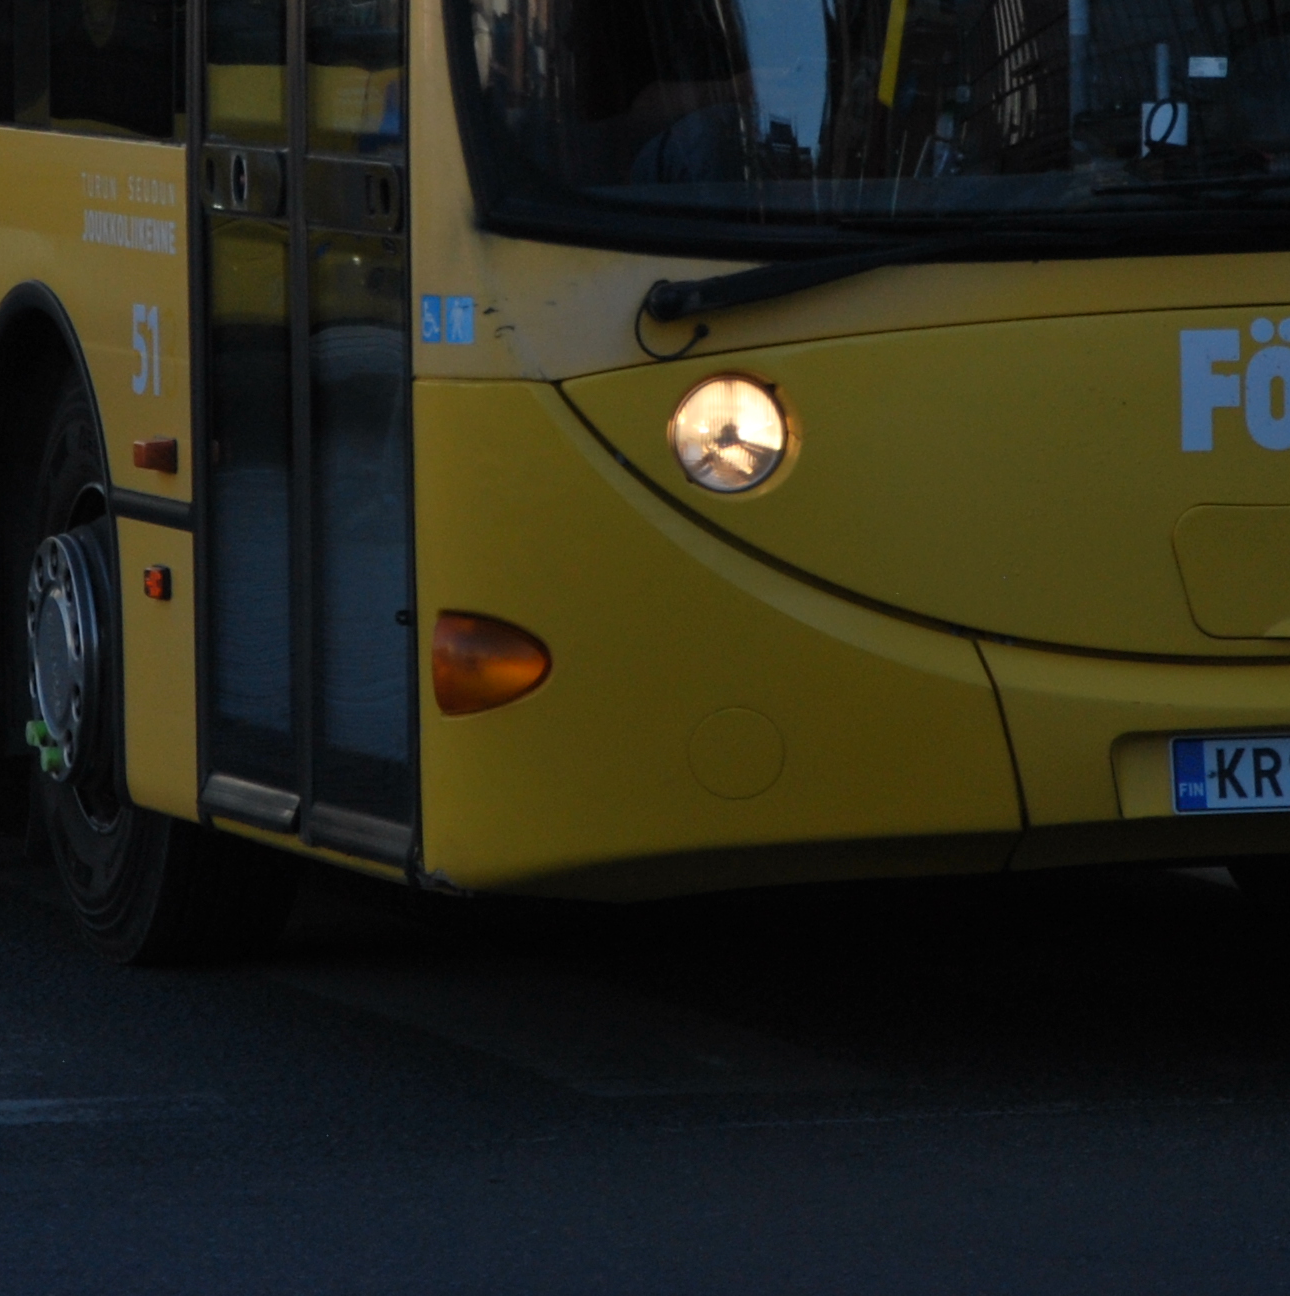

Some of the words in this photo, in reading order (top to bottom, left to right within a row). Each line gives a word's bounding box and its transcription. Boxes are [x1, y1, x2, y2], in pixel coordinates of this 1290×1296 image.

[80, 172, 117, 201] TURUN
[127, 175, 176, 207] SEUDUN
[131, 302, 161, 397] 51
[1179, 782, 1205, 797] FIN
